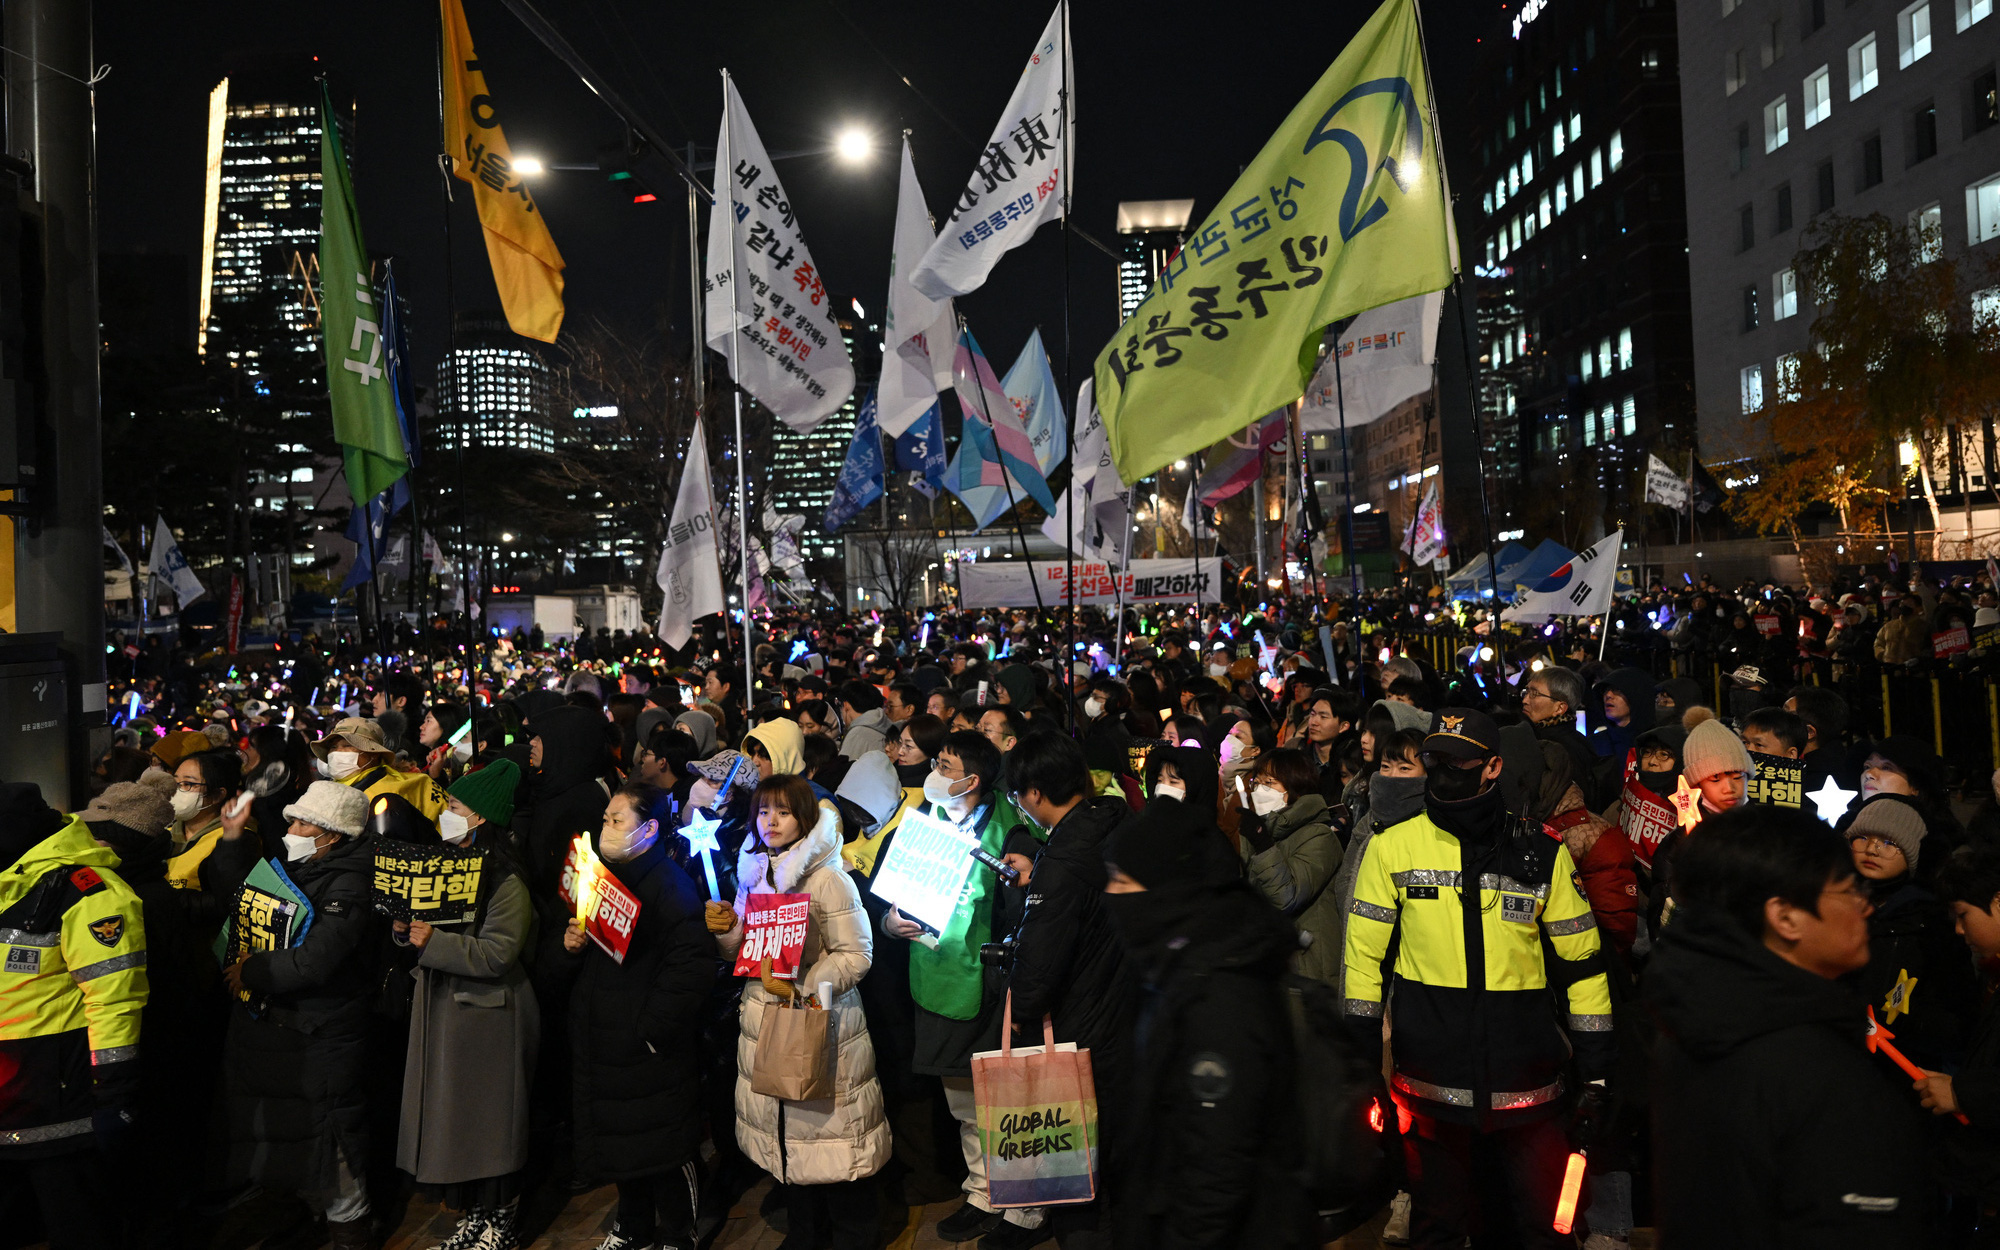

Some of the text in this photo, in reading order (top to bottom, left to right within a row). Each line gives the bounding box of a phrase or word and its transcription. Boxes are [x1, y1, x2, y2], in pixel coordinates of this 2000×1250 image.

[735, 159, 795, 229] 내 손에
[1133, 573, 1210, 597] 폐간하자
[1763, 766, 1802, 783] 윤석열
[1641, 802, 1677, 828] 국민의힘
[374, 855, 483, 875] 내란수괴 윤석열
[374, 870, 481, 910] 즉각 탄핵
[599, 880, 636, 916] 국민의힘
[747, 904, 807, 925] 내란동조 국민의힘
[1504, 896, 1534, 913] 경찰
[1504, 911, 1532, 921] POLICE
[742, 922, 807, 962] 해체하라
[7, 961, 36, 971] POLICE
[11, 948, 37, 963] 경찰
[1000, 1107, 1071, 1140] GLOBAL
[998, 1133, 1073, 1162] GREENS
